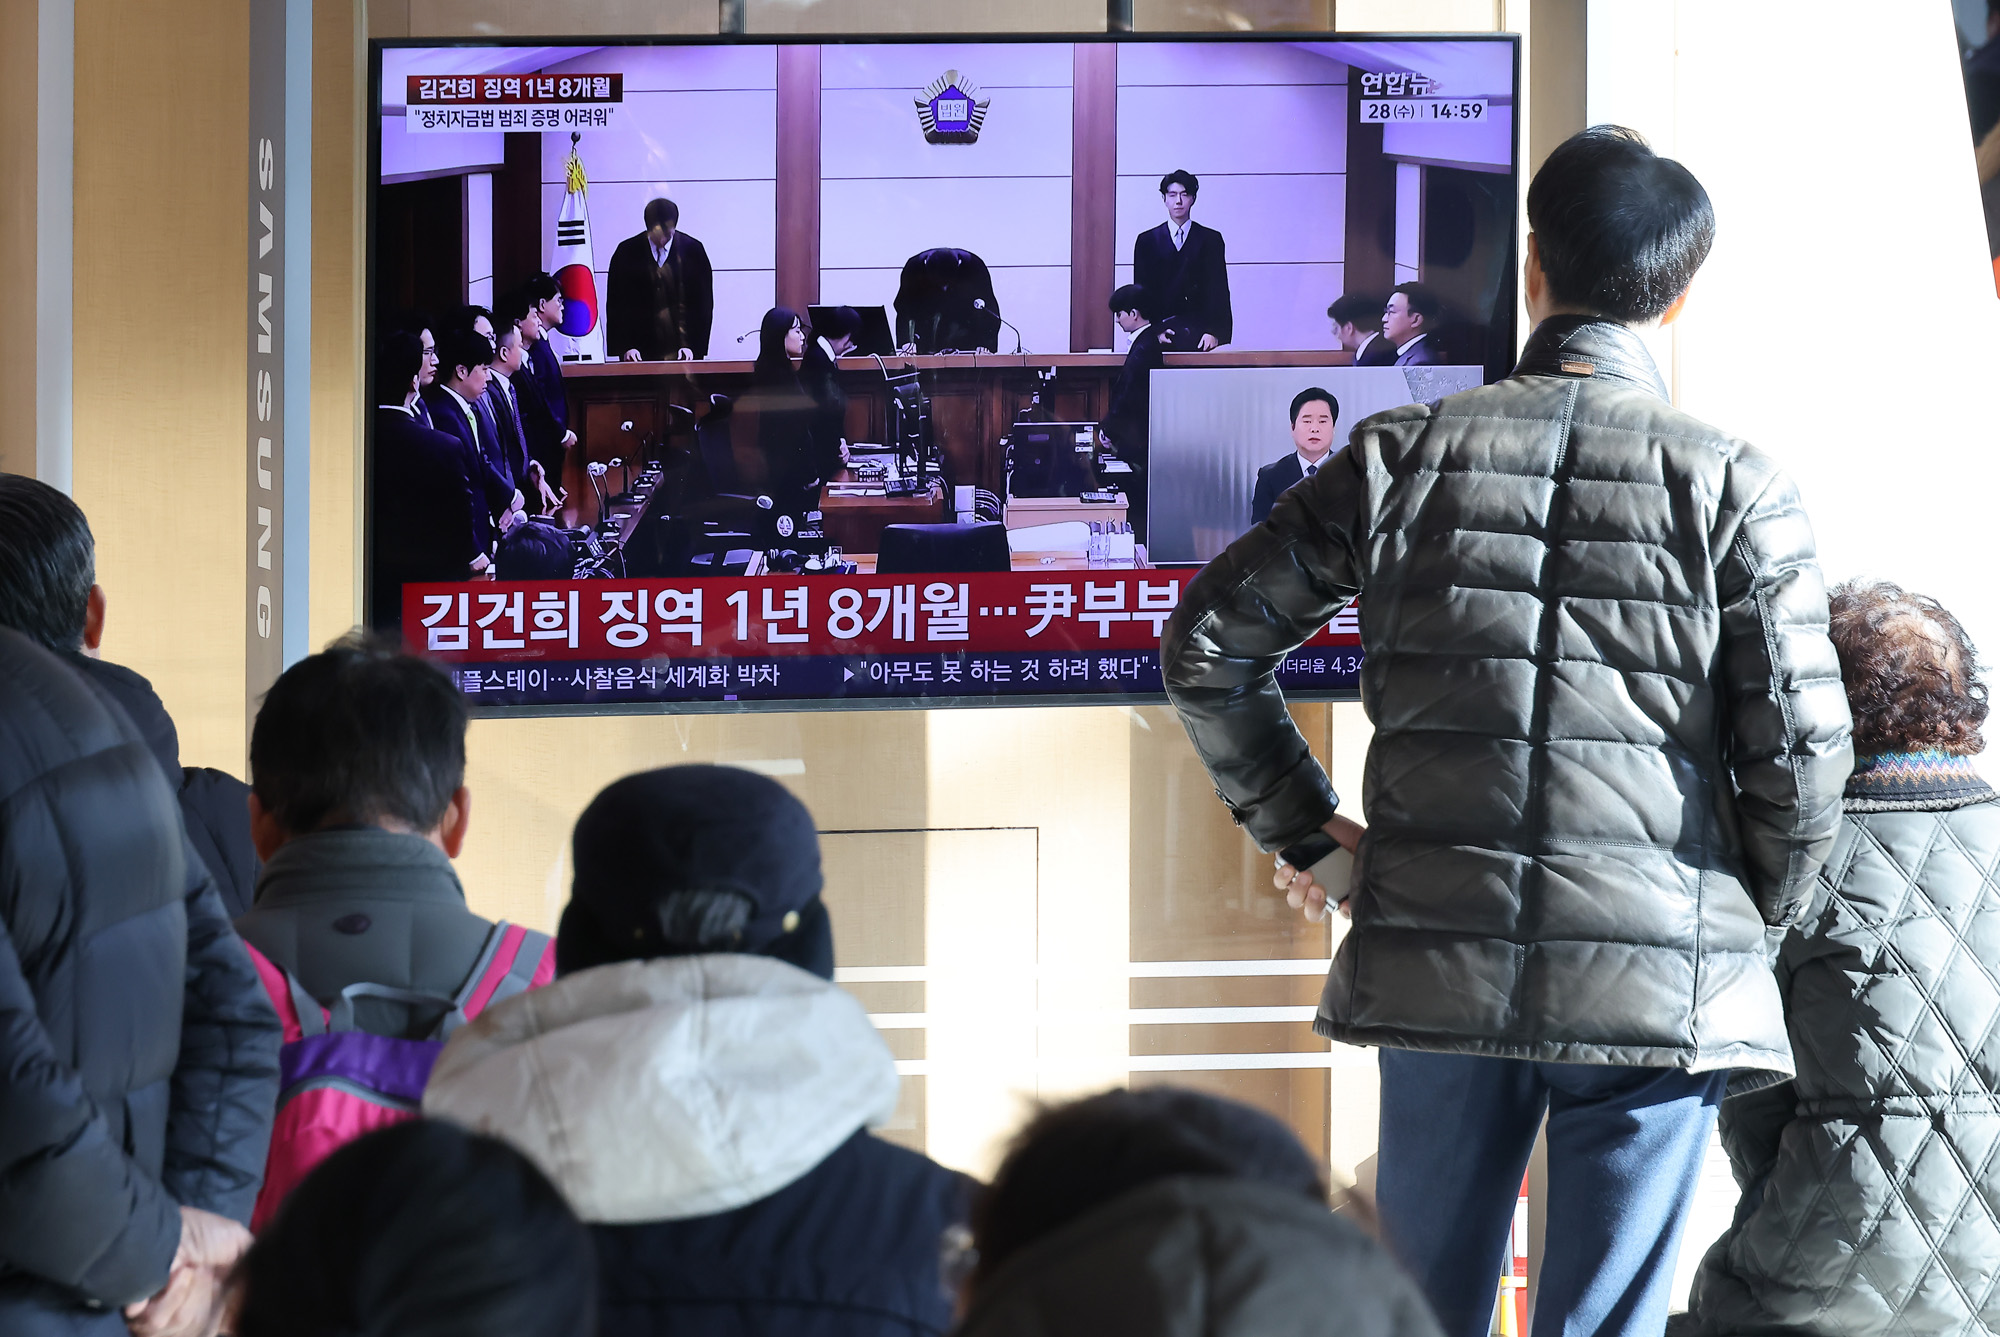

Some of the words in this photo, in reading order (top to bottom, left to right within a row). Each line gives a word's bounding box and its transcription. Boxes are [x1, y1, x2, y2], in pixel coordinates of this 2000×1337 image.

[419, 78, 476, 99] 김건희
[483, 78, 521, 98] 징역
[525, 78, 554, 98] 1년
[558, 77, 611, 98] 8개월
[414, 109, 494, 129] "정치자금법
[499, 109, 527, 128] 범죄
[530, 108, 560, 127] 증명
[564, 107, 614, 127] 어려워"
[1368, 103, 1415, 119] 28(수)
[1431, 103, 1483, 119] 14:59
[256, 137, 274, 640] SAMSUNG
[420, 589, 580, 651] 김건희
[598, 587, 703, 648] 징역
[725, 586, 810, 644] 1년
[664, 664, 730, 689] 세계화
[737, 663, 781, 687] 박차
[859, 659, 935, 684] "아무도
[941, 659, 963, 684] 못
[969, 658, 1013, 683] 하는
[1019, 658, 1040, 682] 것
[1048, 657, 1090, 681] 하려
